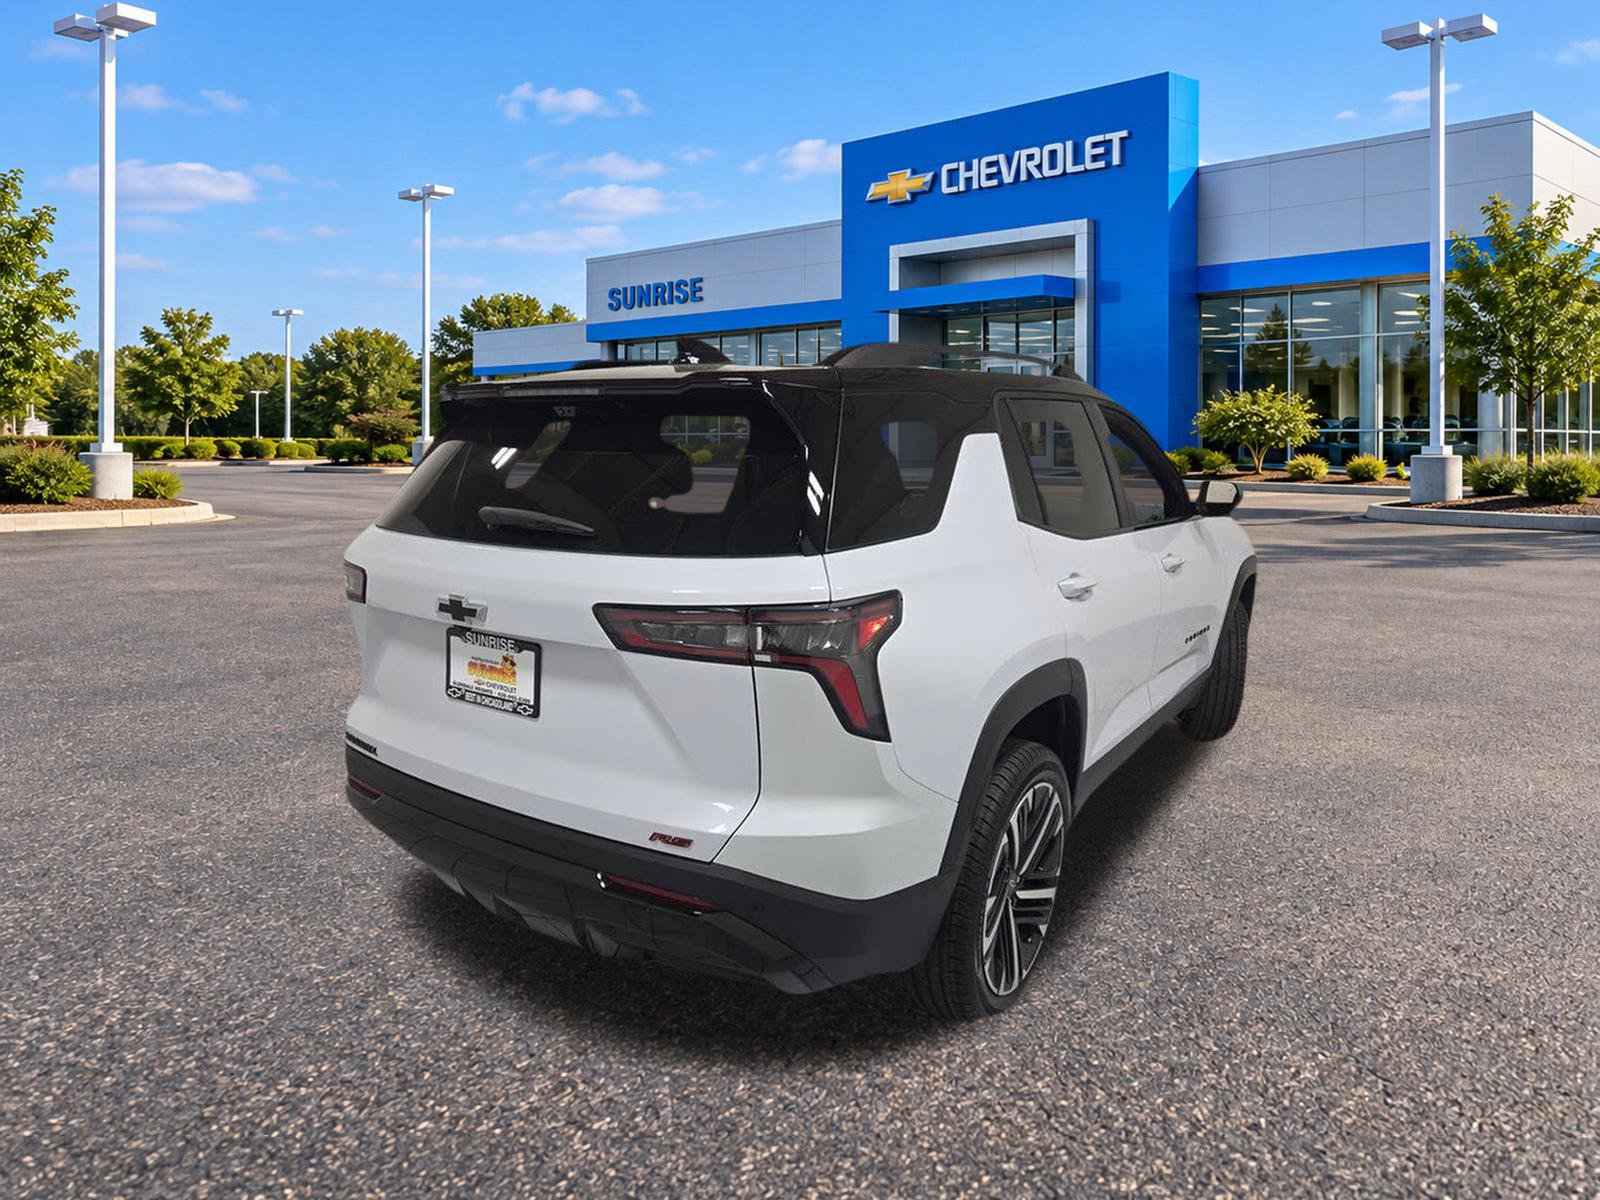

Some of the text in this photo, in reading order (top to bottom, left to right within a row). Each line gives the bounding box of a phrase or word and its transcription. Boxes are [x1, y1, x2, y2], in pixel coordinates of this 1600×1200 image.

[941, 130, 1129, 195] CHEVROLET
[608, 277, 704, 312] SUNRISE
[465, 632, 515, 651] SUNRISE
[486, 682, 517, 693] CHEVROLET
